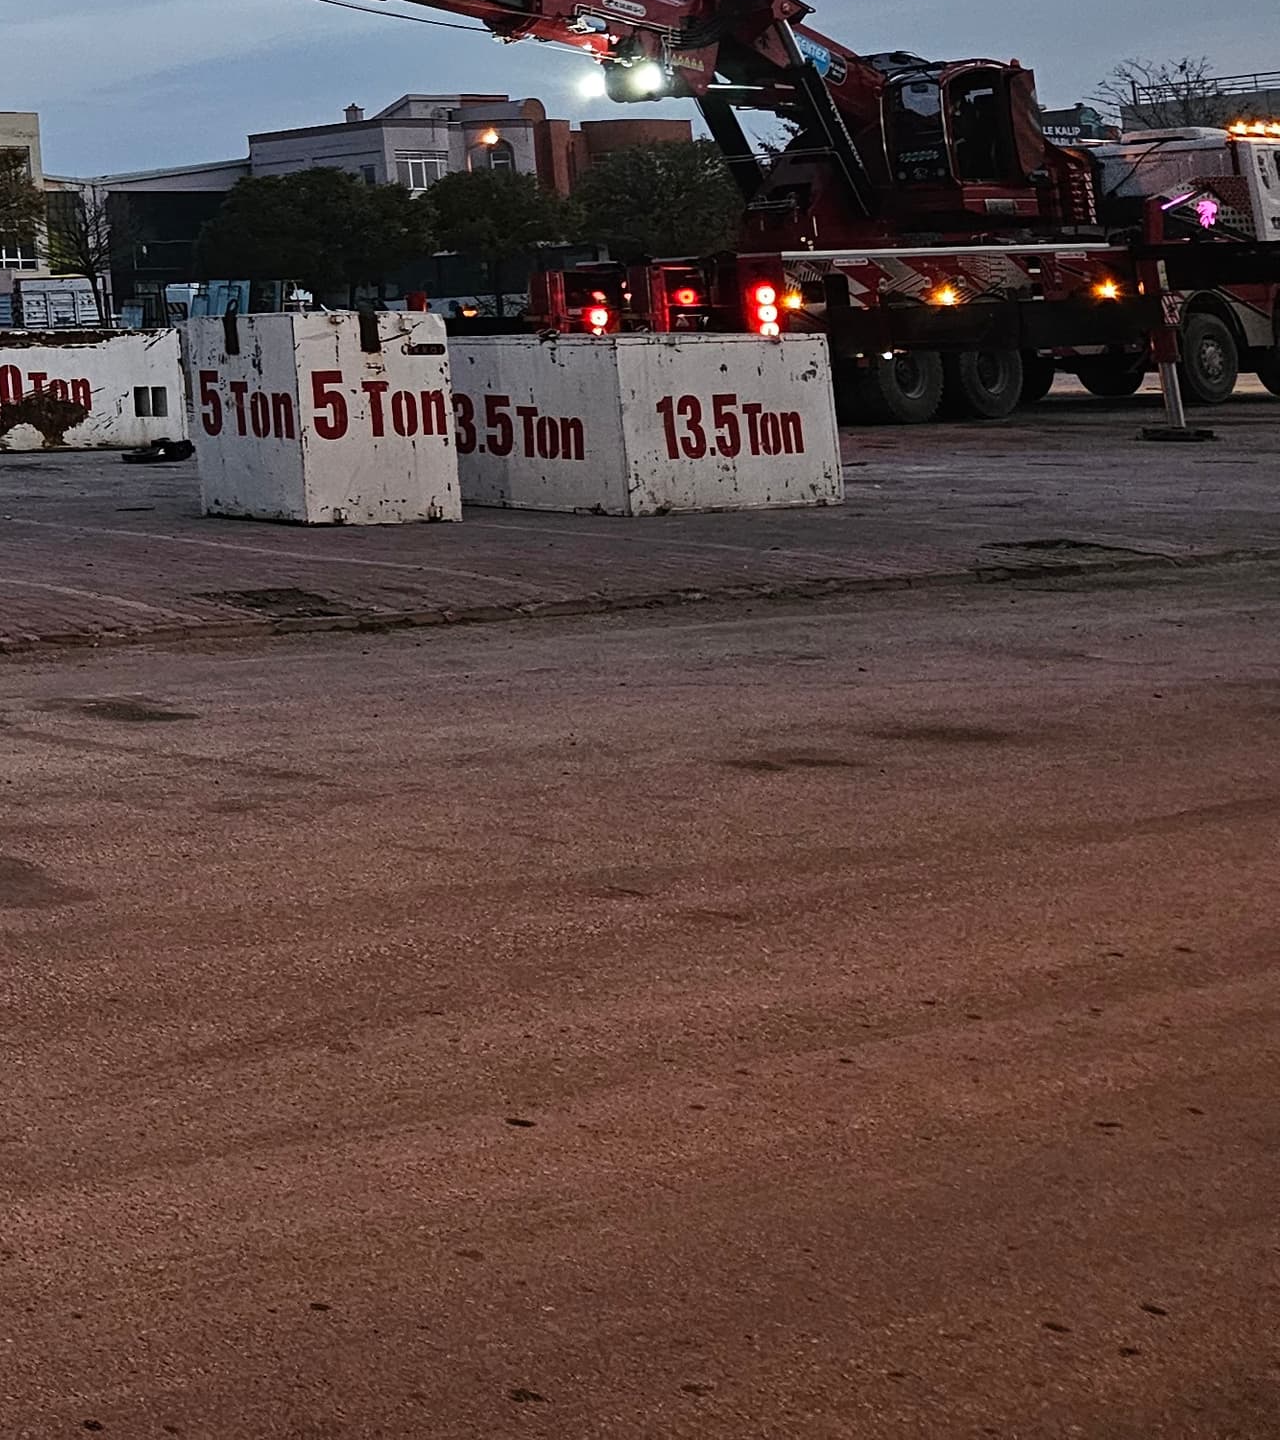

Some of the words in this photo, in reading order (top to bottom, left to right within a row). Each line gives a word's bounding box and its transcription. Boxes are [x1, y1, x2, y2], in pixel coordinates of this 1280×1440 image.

[198, 370, 223, 437] 5
[229, 381, 295, 440] Ton
[311, 370, 349, 440] 5
[361, 380, 448, 437] Ton
